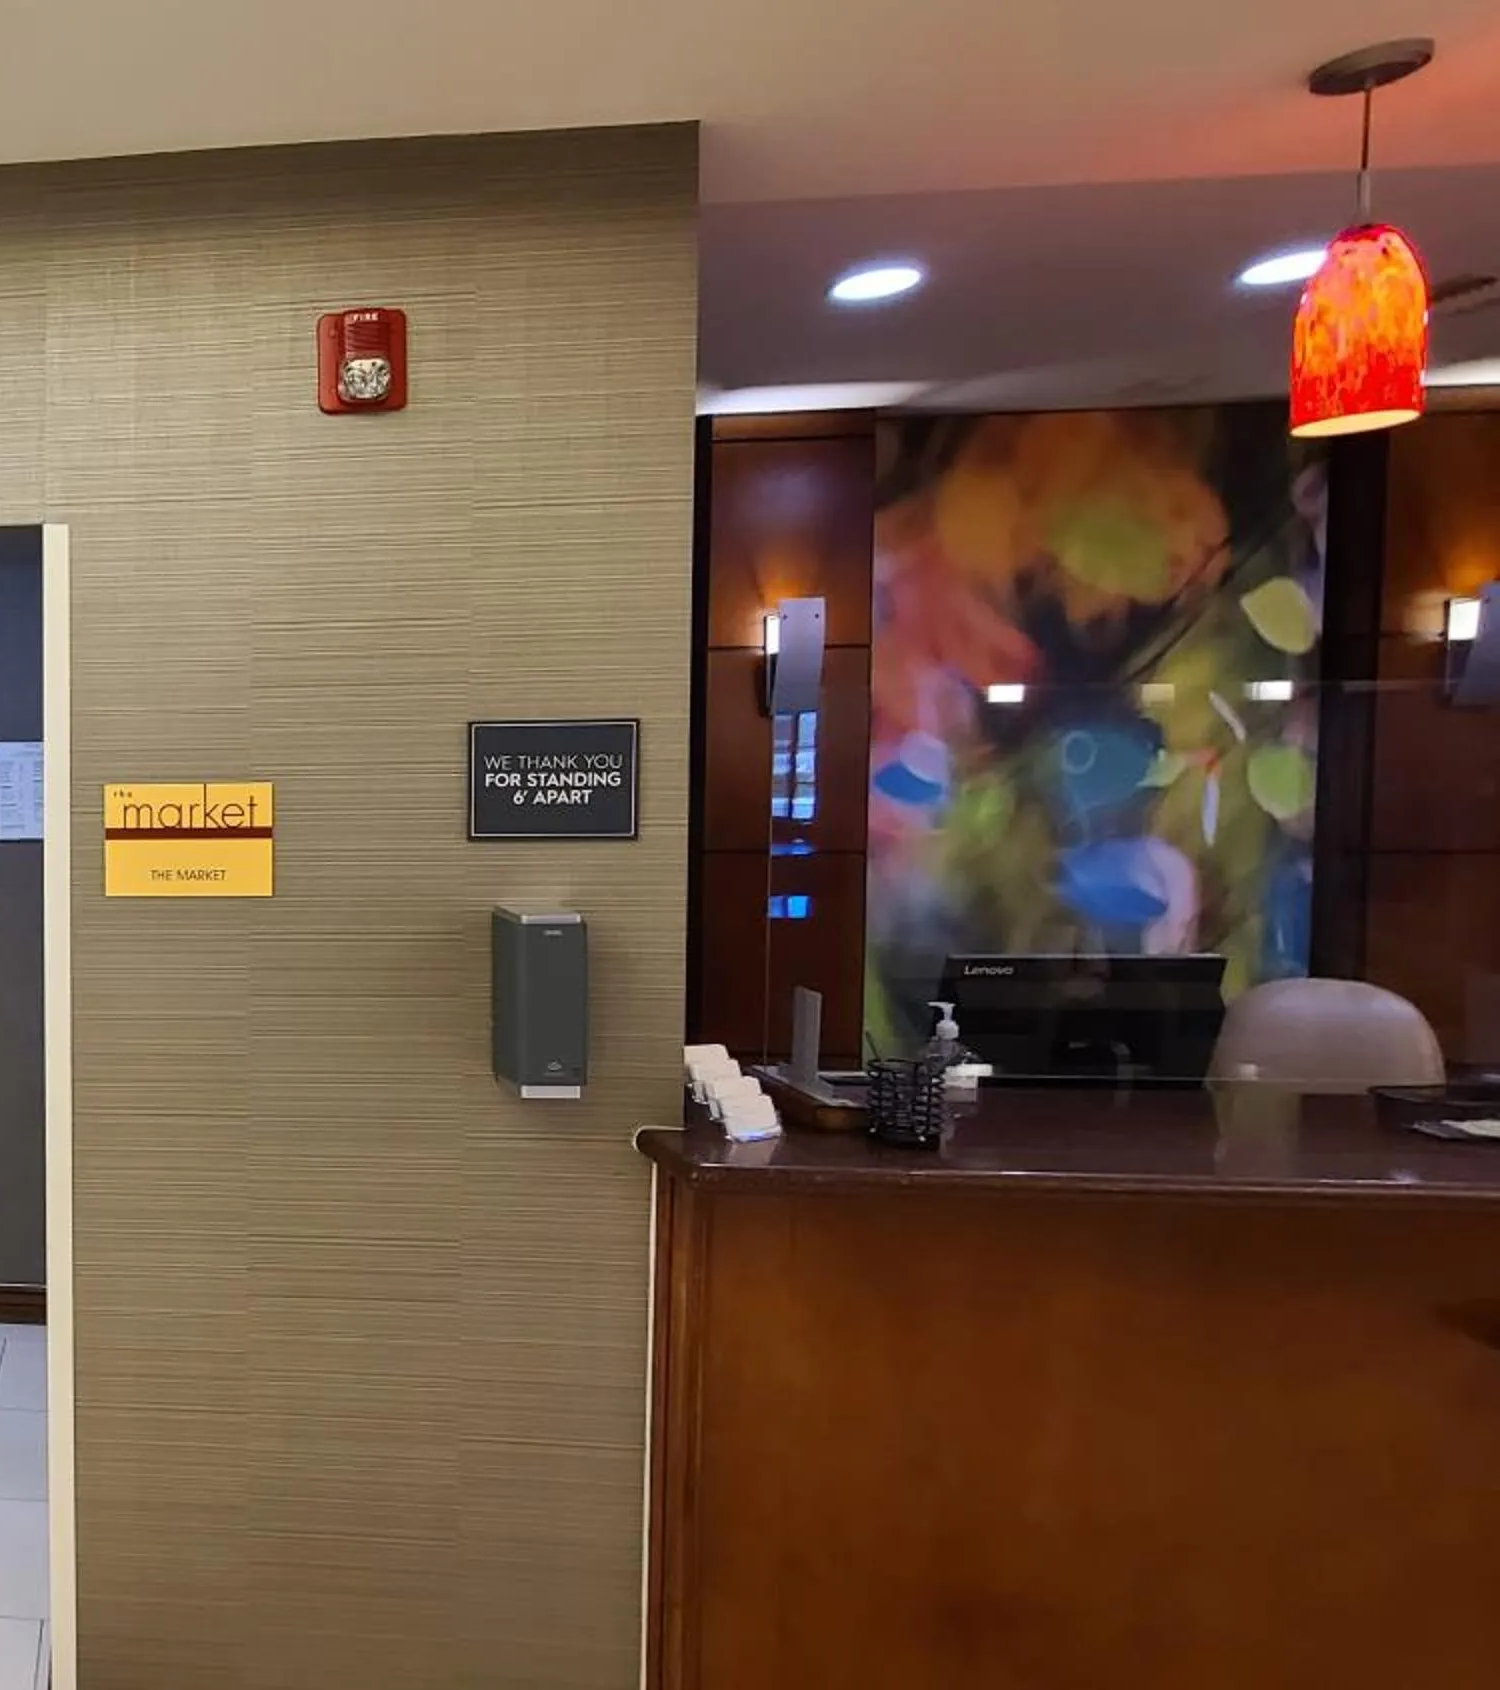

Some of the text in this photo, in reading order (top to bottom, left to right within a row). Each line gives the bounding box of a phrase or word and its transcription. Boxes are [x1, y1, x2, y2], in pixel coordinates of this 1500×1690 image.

[484, 754, 623, 770] WE THANK YOU
[485, 772, 621, 787] FOR STANDING
[532, 789, 593, 805] APART
[123, 783, 258, 829] market
[150, 869, 226, 881] THE MARKET
[964, 964, 1014, 976] Lenovo
